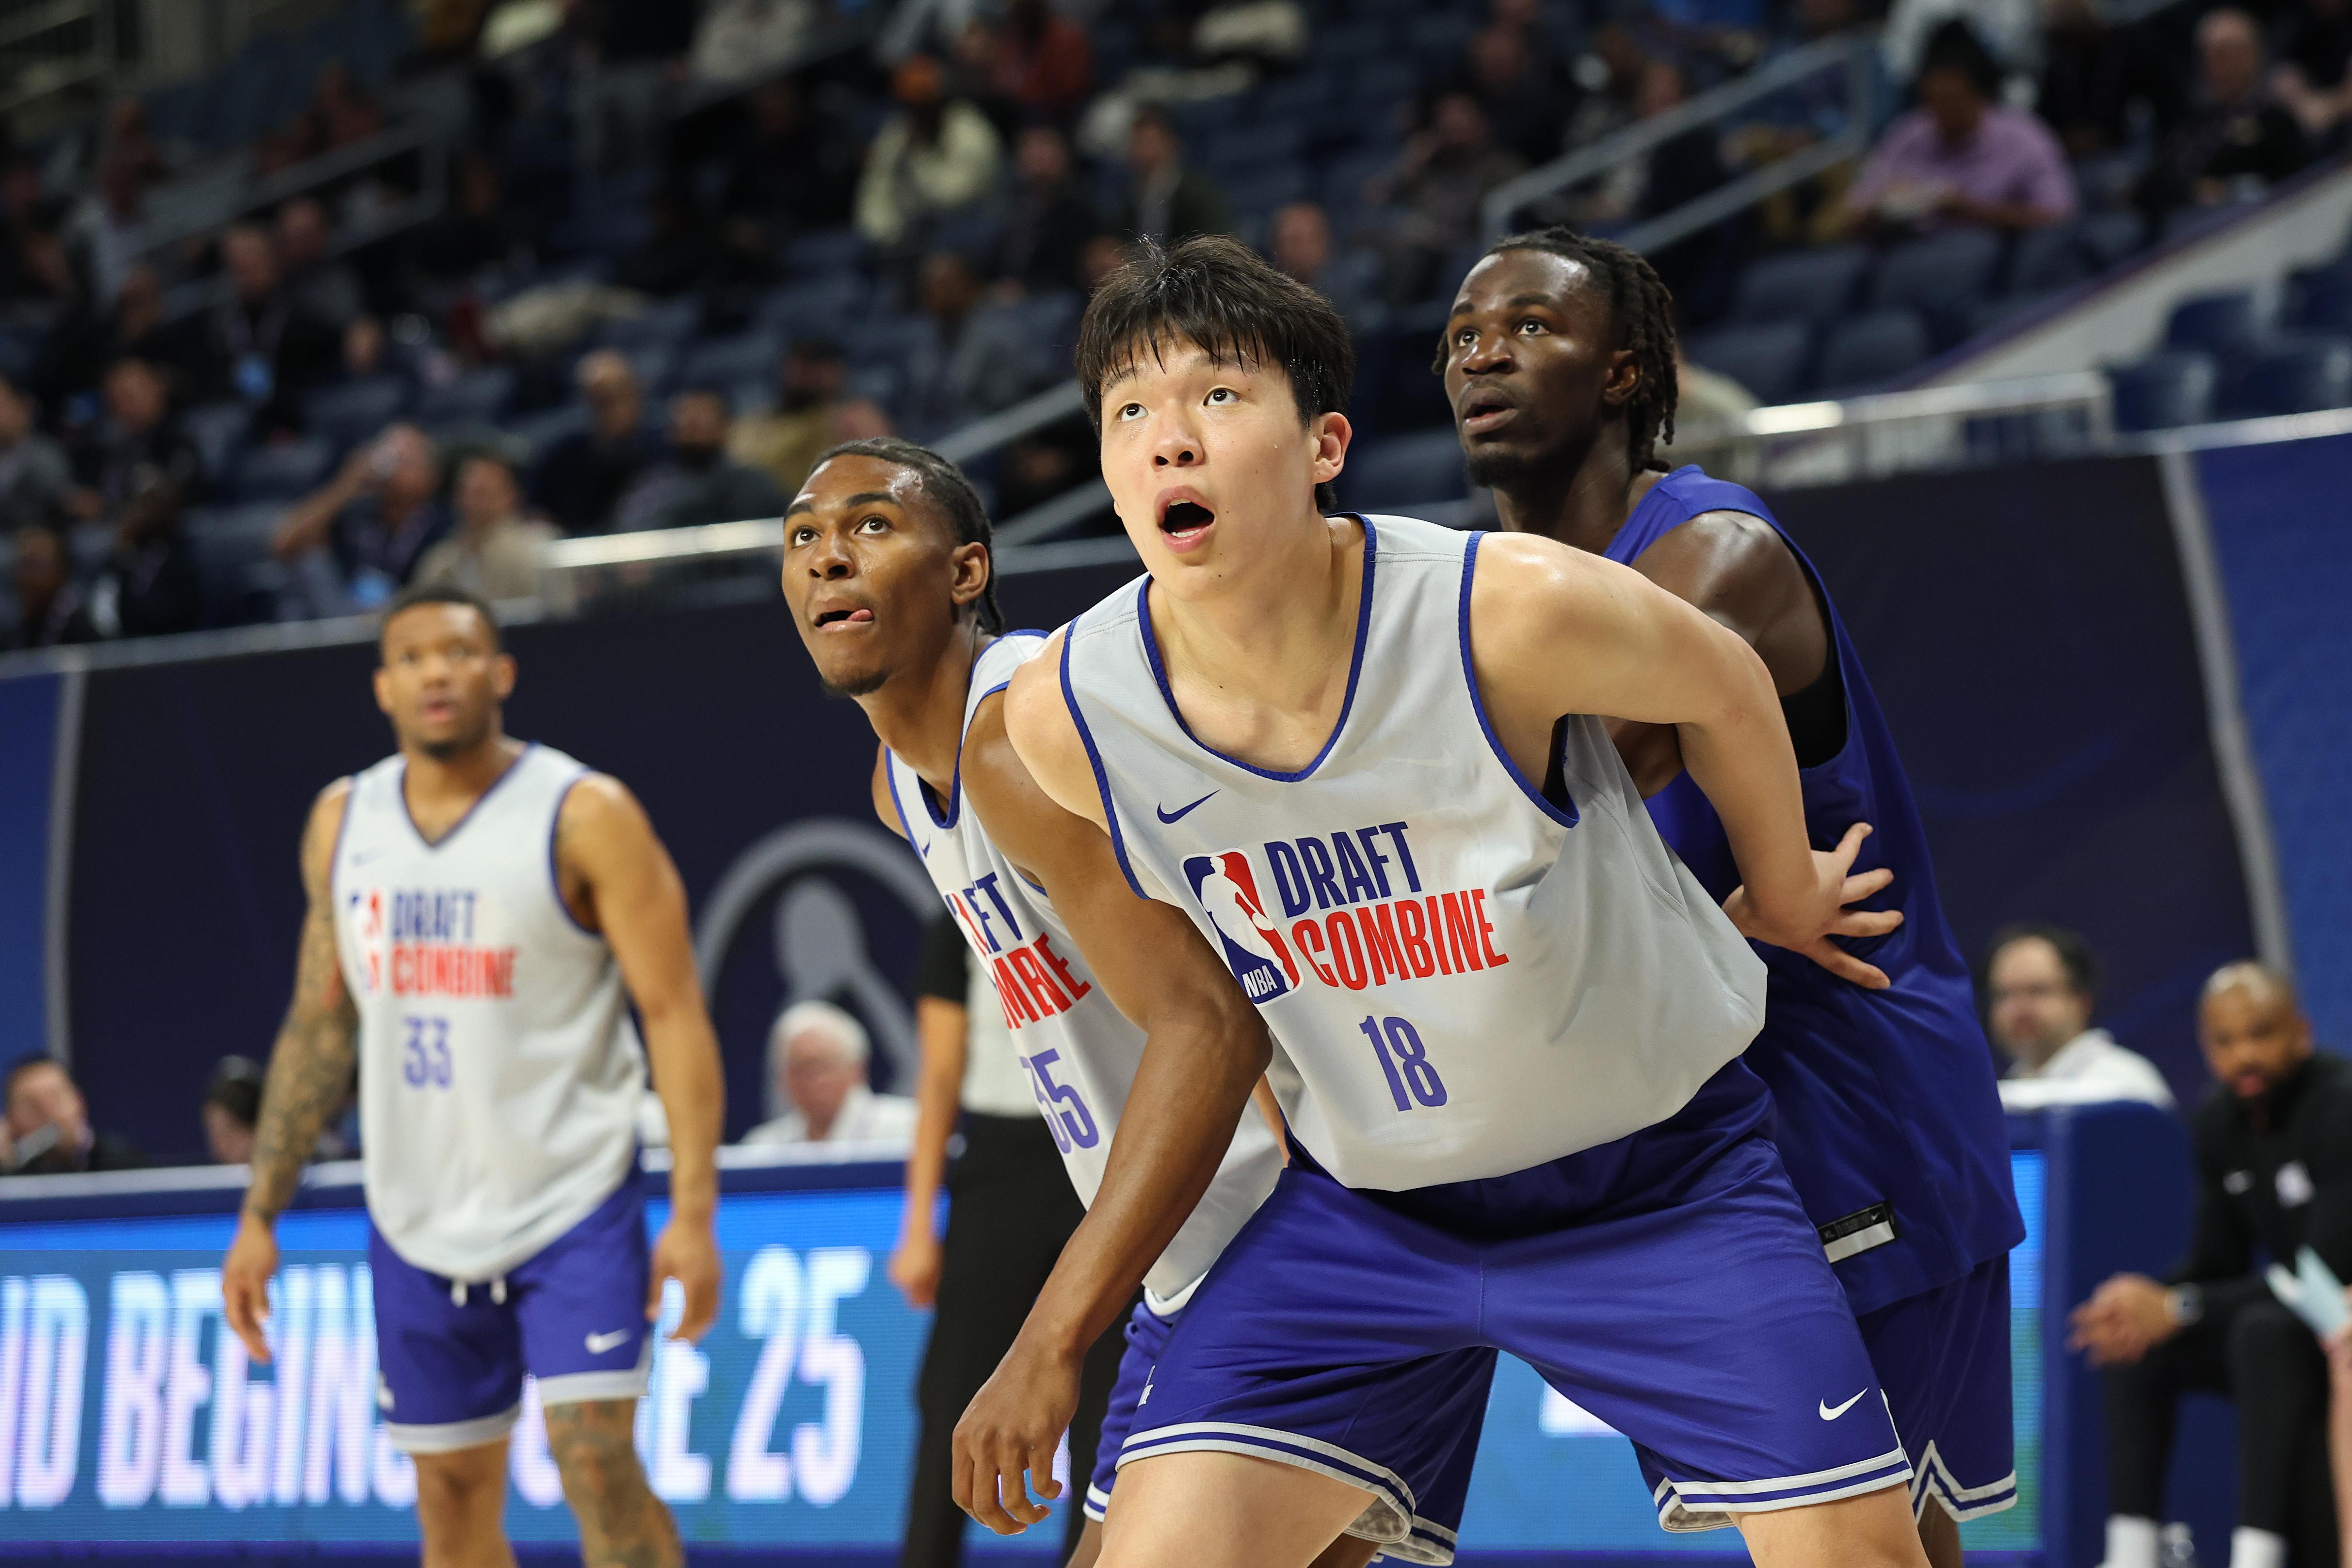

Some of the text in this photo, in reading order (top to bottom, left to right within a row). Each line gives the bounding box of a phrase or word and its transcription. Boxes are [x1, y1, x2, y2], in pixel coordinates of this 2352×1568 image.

[1264, 821, 1423, 918] DRAFT
[391, 890, 476, 942] DRAFT
[1291, 889, 1509, 991] COMBINE
[391, 944, 517, 999] COMBINE
[1242, 965, 1278, 998] NBA
[404, 1017, 452, 1089] 33
[1359, 1016, 1447, 1112] 18
[725, 1243, 873, 1508] 25
